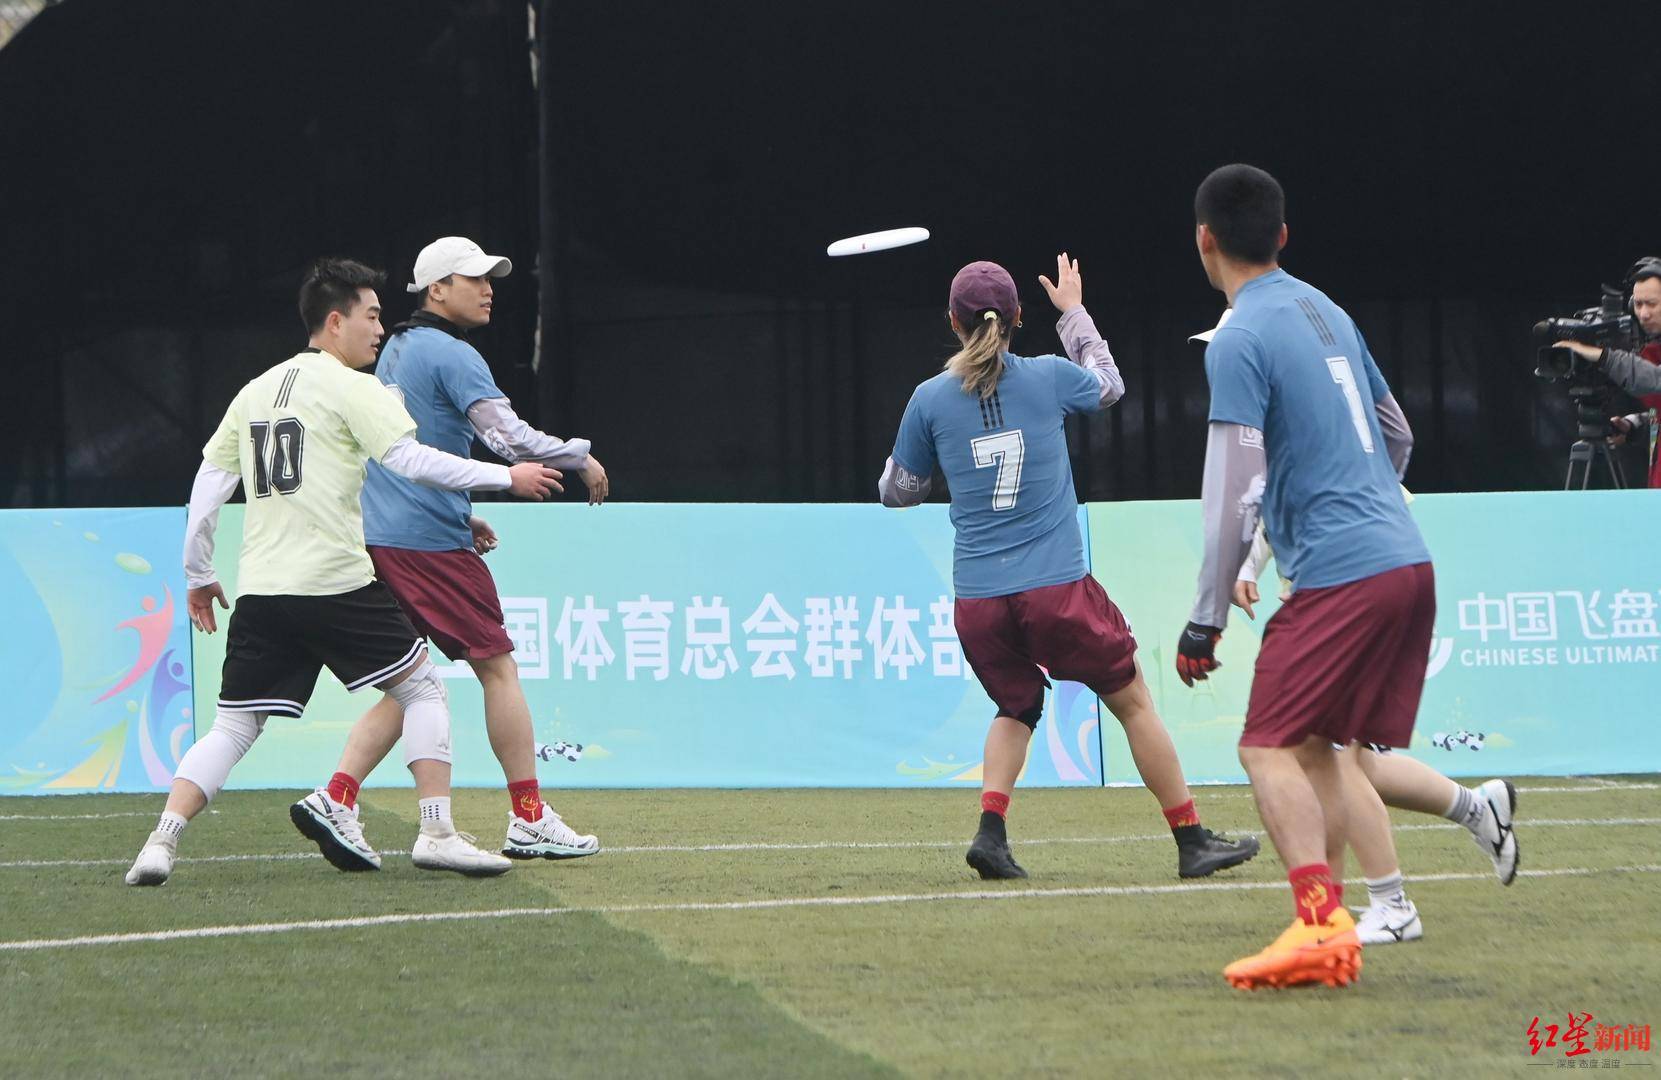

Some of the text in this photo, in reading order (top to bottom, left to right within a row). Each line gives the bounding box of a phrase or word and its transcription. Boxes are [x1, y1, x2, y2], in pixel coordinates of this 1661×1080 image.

[1324, 356, 1375, 454] 1
[249, 417, 305, 499] 10
[970, 428, 1025, 512] 7
[436, 593, 973, 681] 国体育总会群体部
[1460, 644, 1660, 667] CHINESE ULTIMAT
